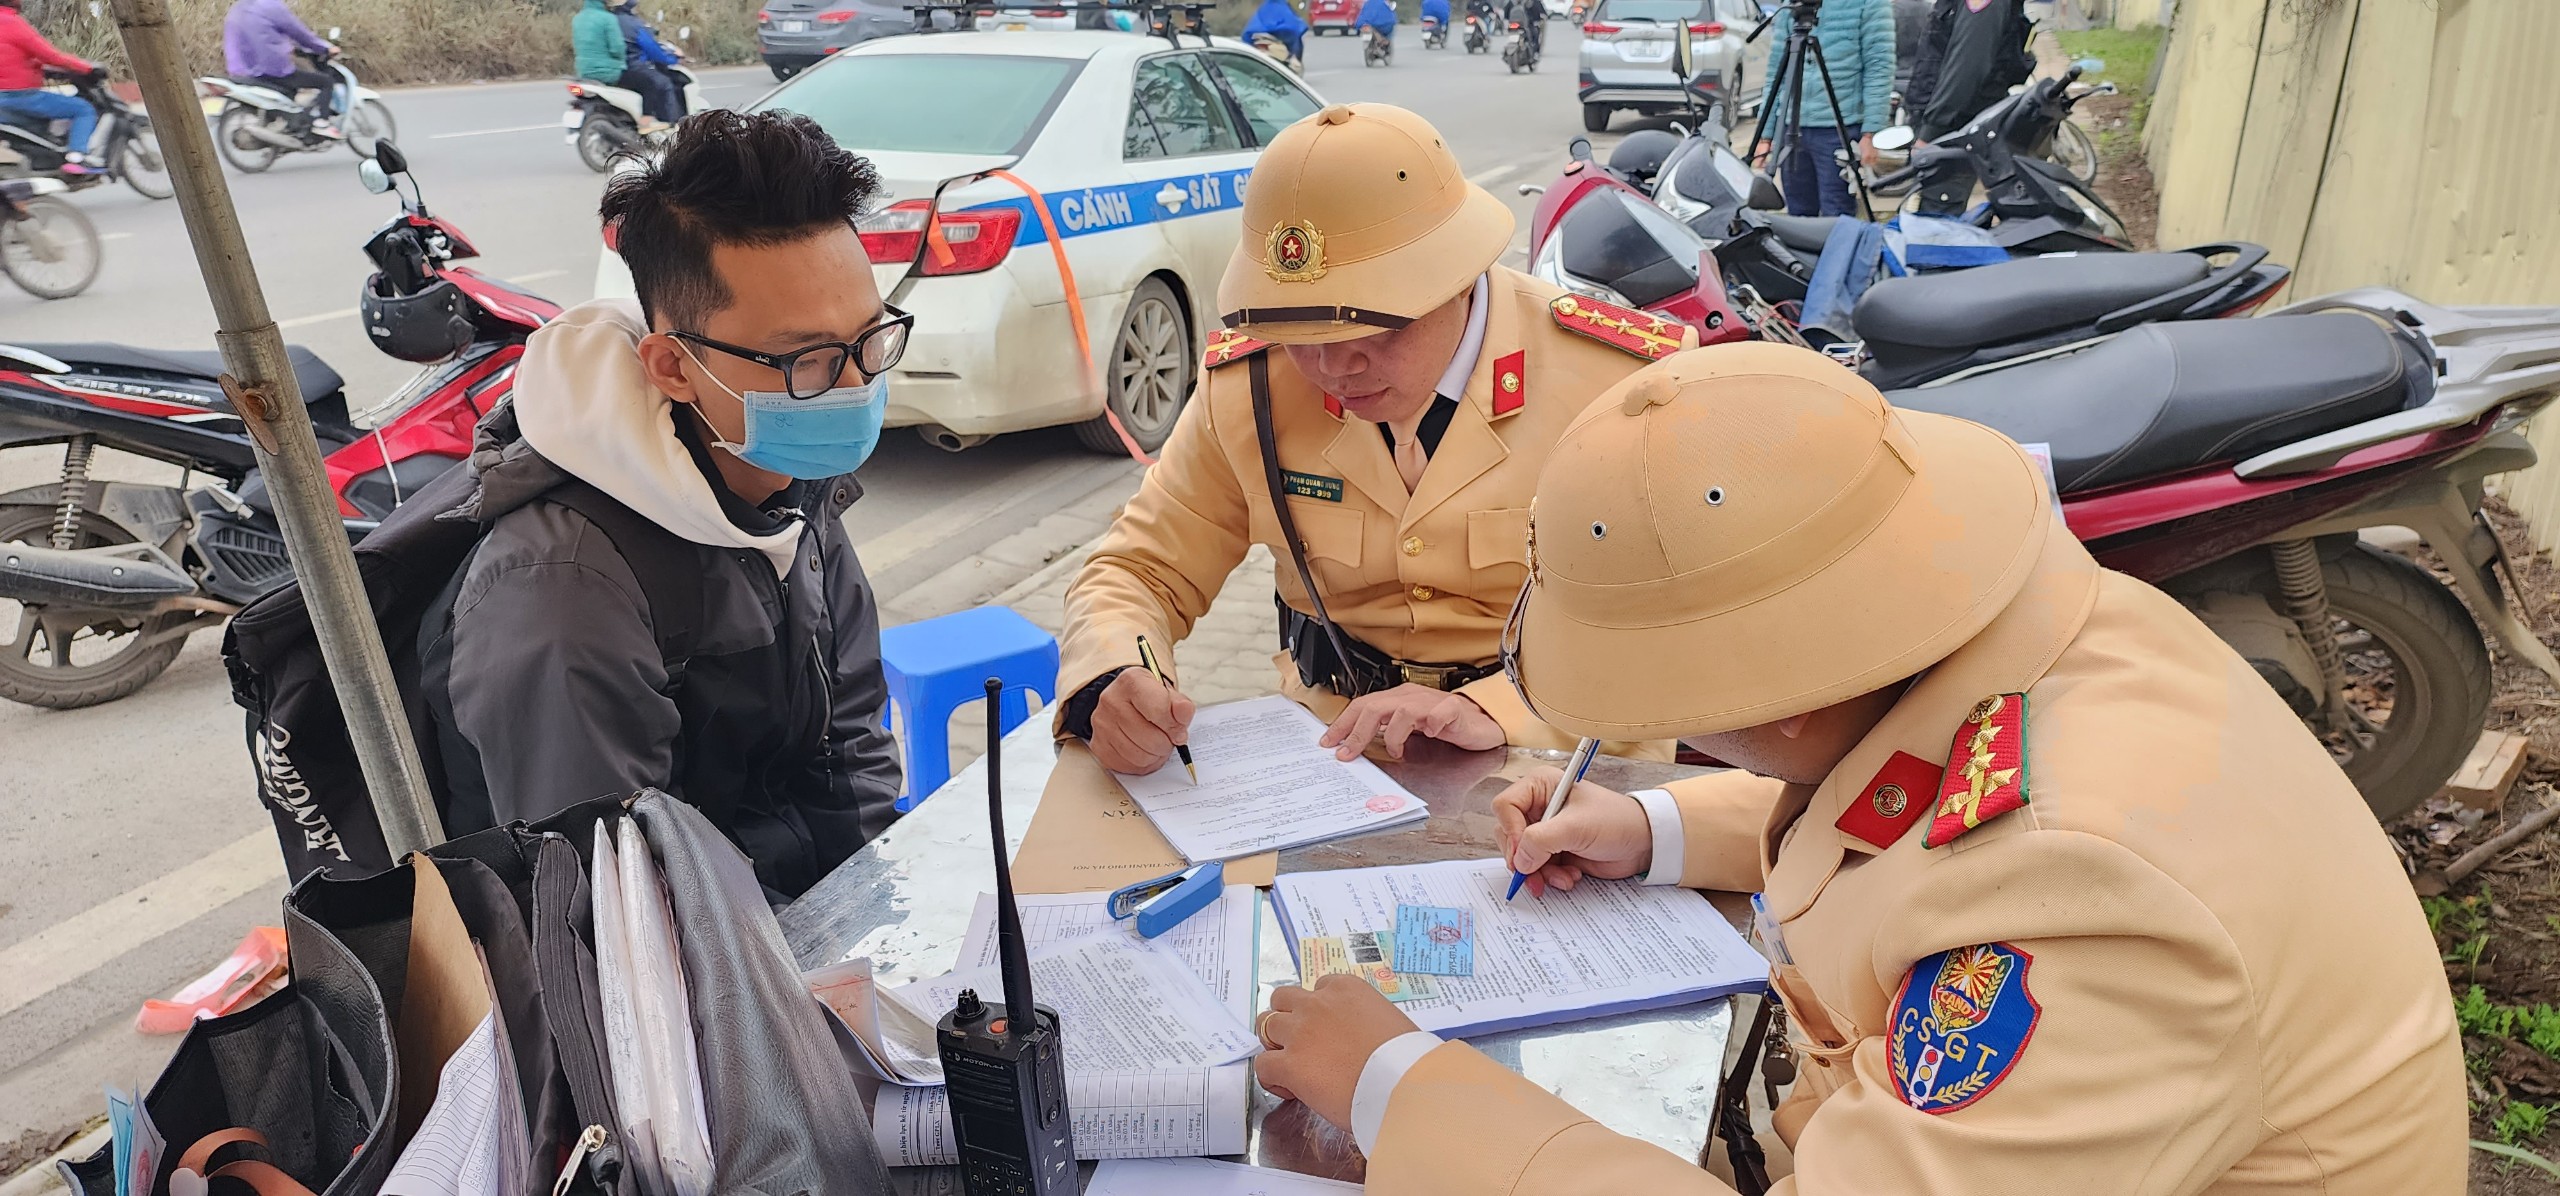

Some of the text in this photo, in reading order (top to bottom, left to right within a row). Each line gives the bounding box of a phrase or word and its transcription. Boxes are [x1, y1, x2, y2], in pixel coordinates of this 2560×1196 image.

[1060, 188, 1133, 232] CẢNH
[1188, 173, 1223, 210] SÁT
[1940, 991, 1971, 1016] CAND
